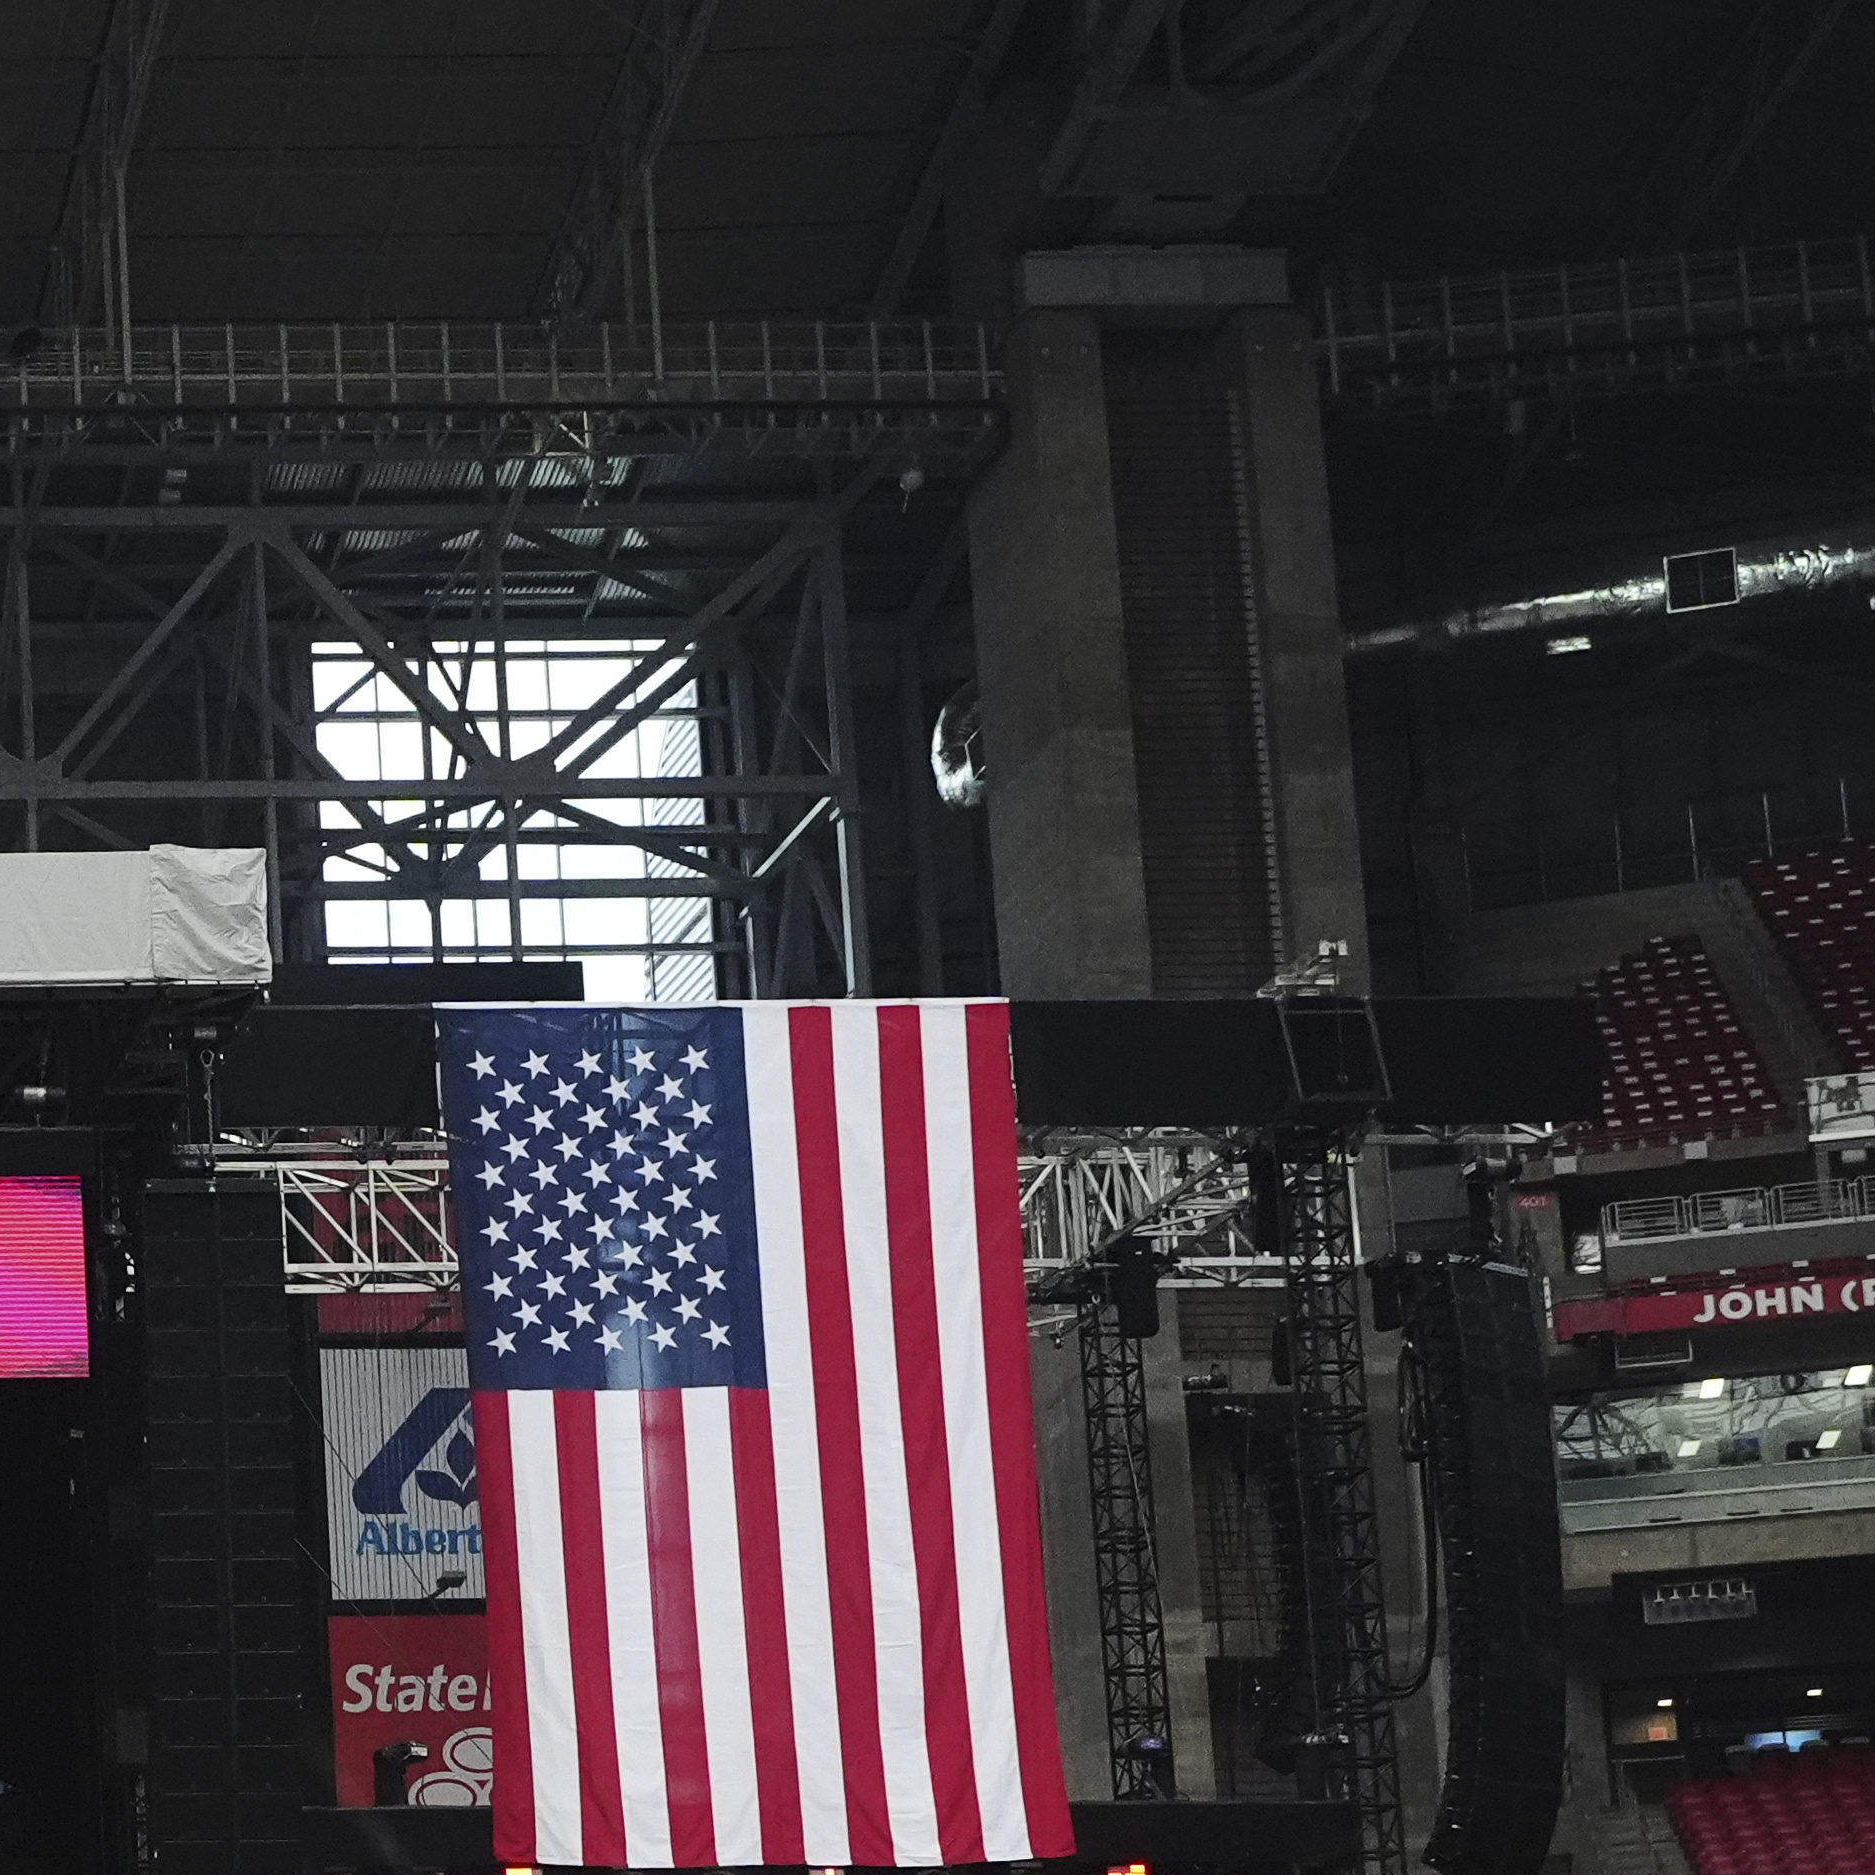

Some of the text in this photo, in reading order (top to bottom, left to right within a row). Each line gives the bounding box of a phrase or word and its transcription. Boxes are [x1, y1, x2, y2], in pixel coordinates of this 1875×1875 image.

[1693, 1283, 1825, 1323] JOHN
[356, 1521, 483, 1555] Albert
[342, 1664, 477, 1714] State
